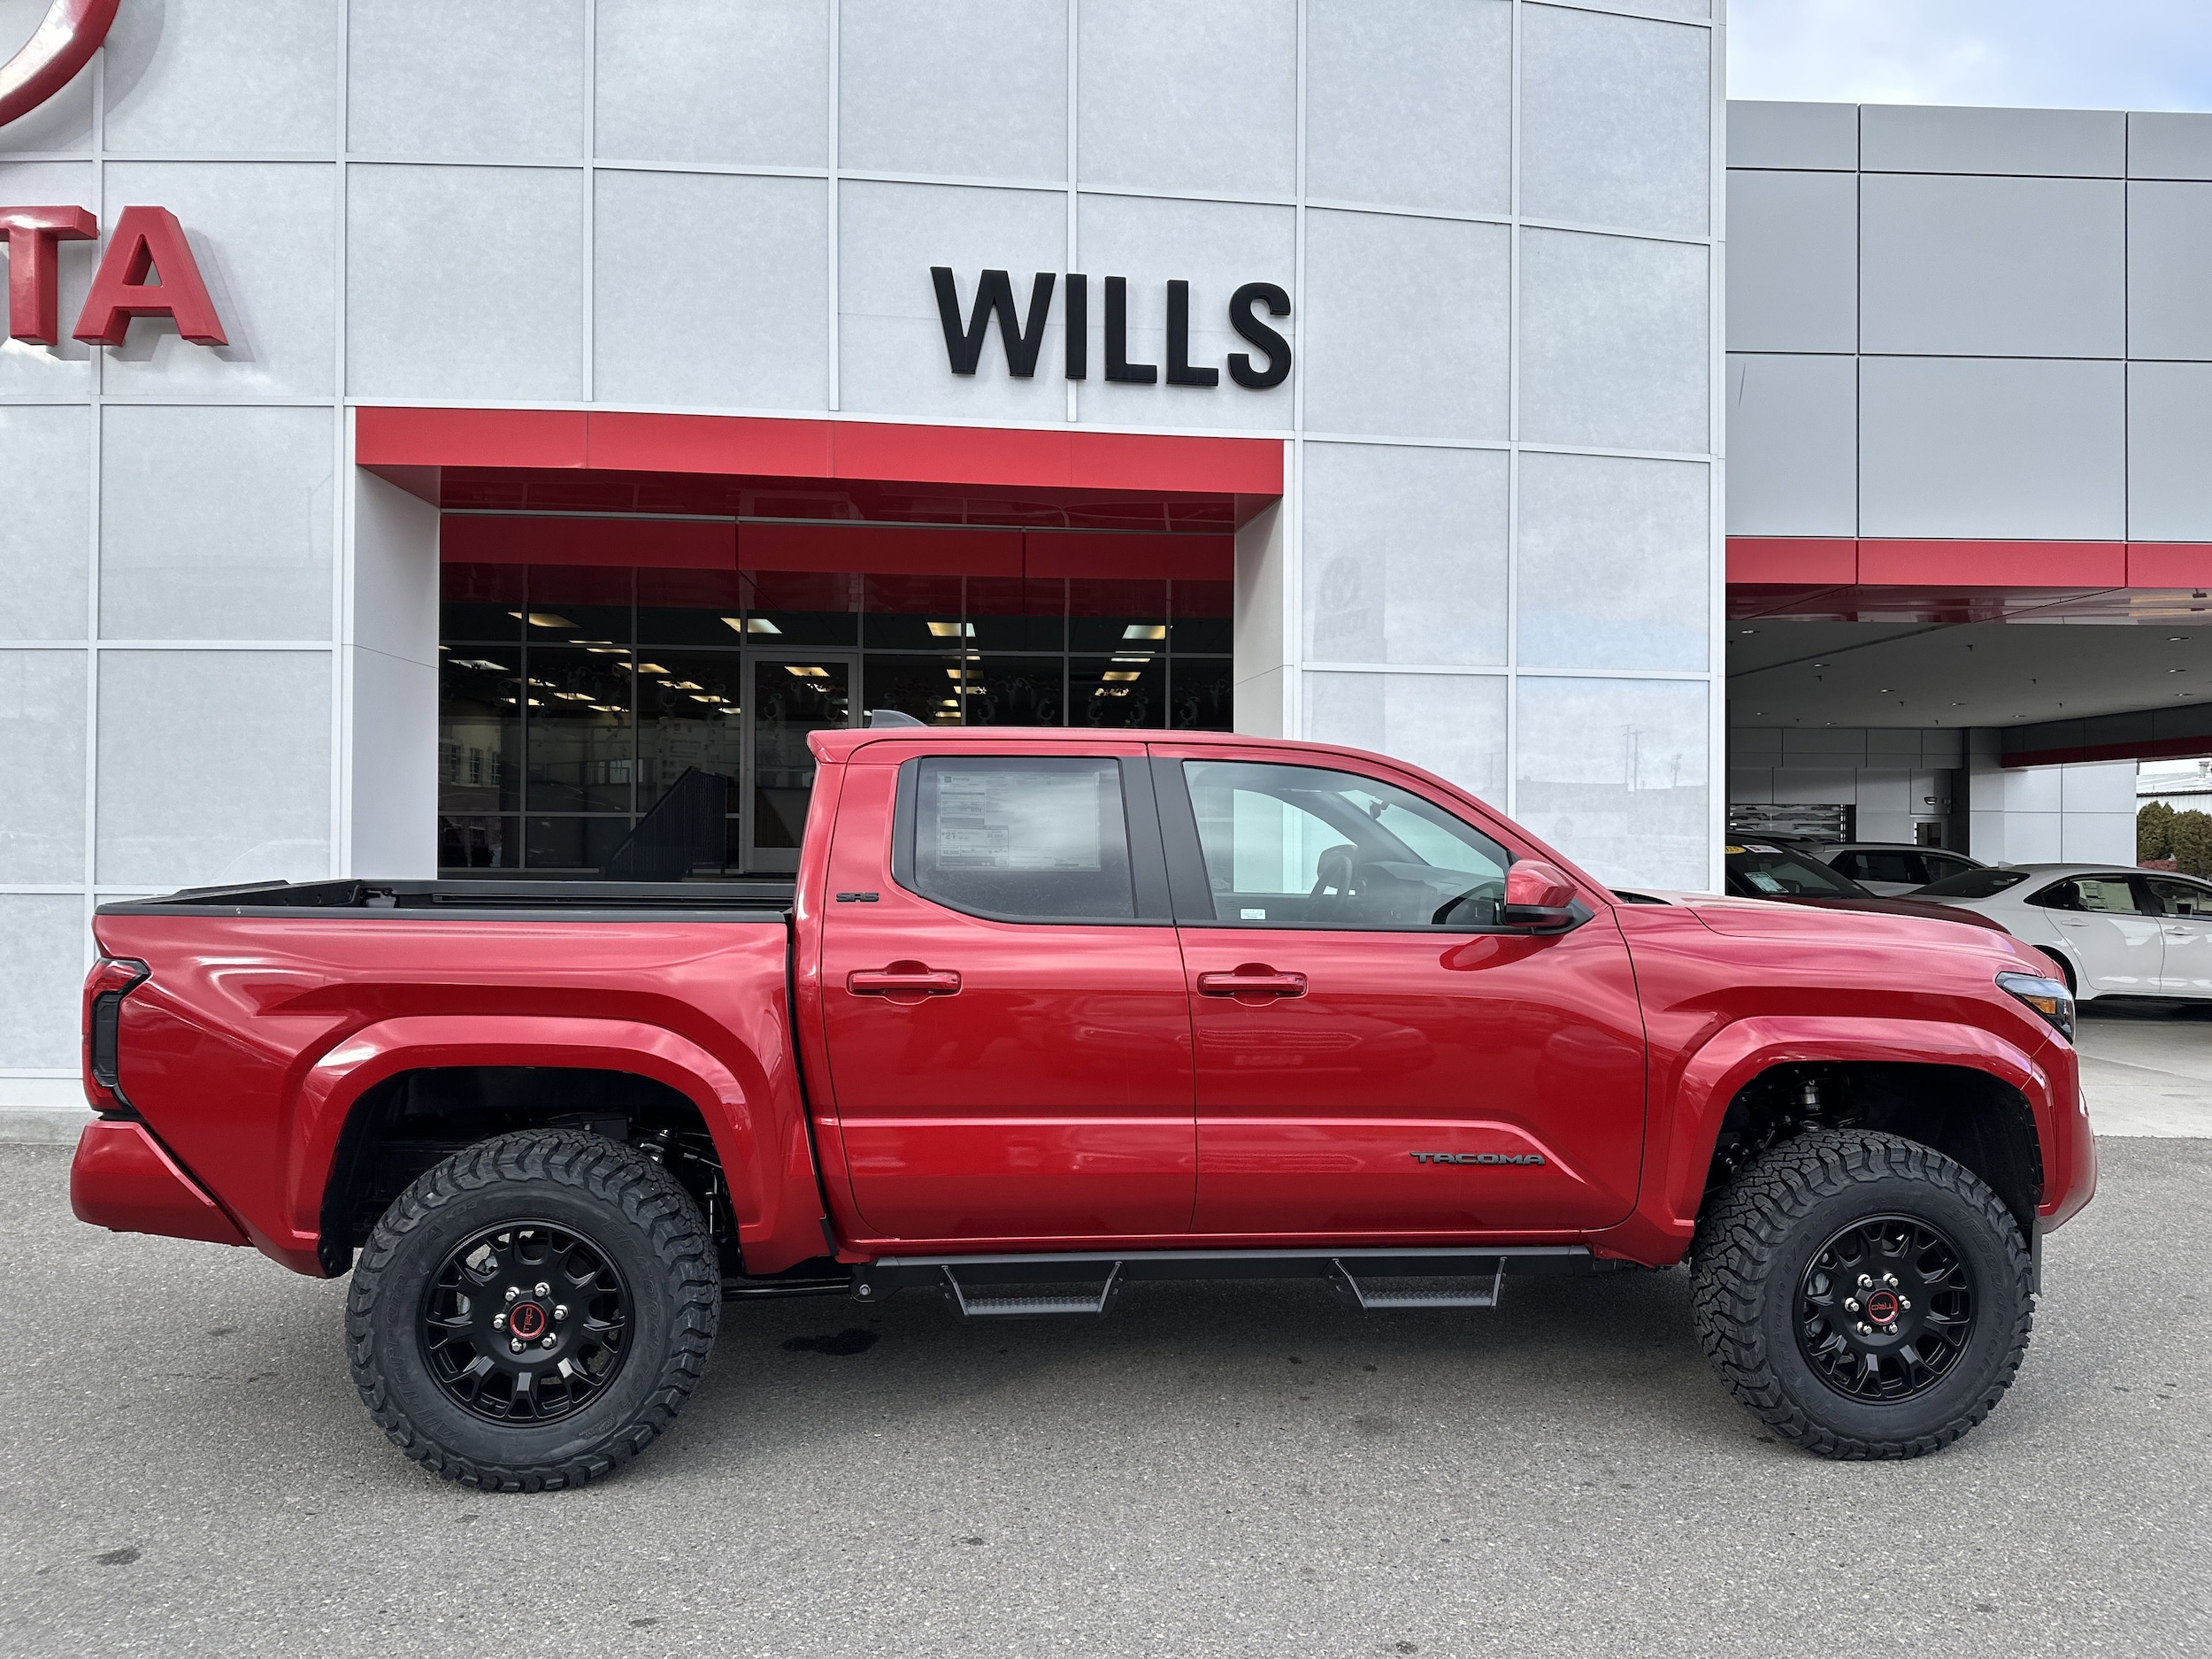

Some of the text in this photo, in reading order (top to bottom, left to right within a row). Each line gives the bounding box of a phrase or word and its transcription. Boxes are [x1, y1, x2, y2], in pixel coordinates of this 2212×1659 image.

[930, 266, 1292, 389] WILLS
[836, 892, 879, 902] SR5
[1409, 1151, 1546, 1165] TACOMA
[403, 1222, 445, 1270] T/A
[601, 1218, 660, 1413] BFGoodrich
[1871, 1302, 1893, 1311] TRD
[1942, 1204, 2007, 1379] BFGoodrich
[523, 1308, 534, 1333] TRD
[385, 1273, 464, 1440] All-Terrain
